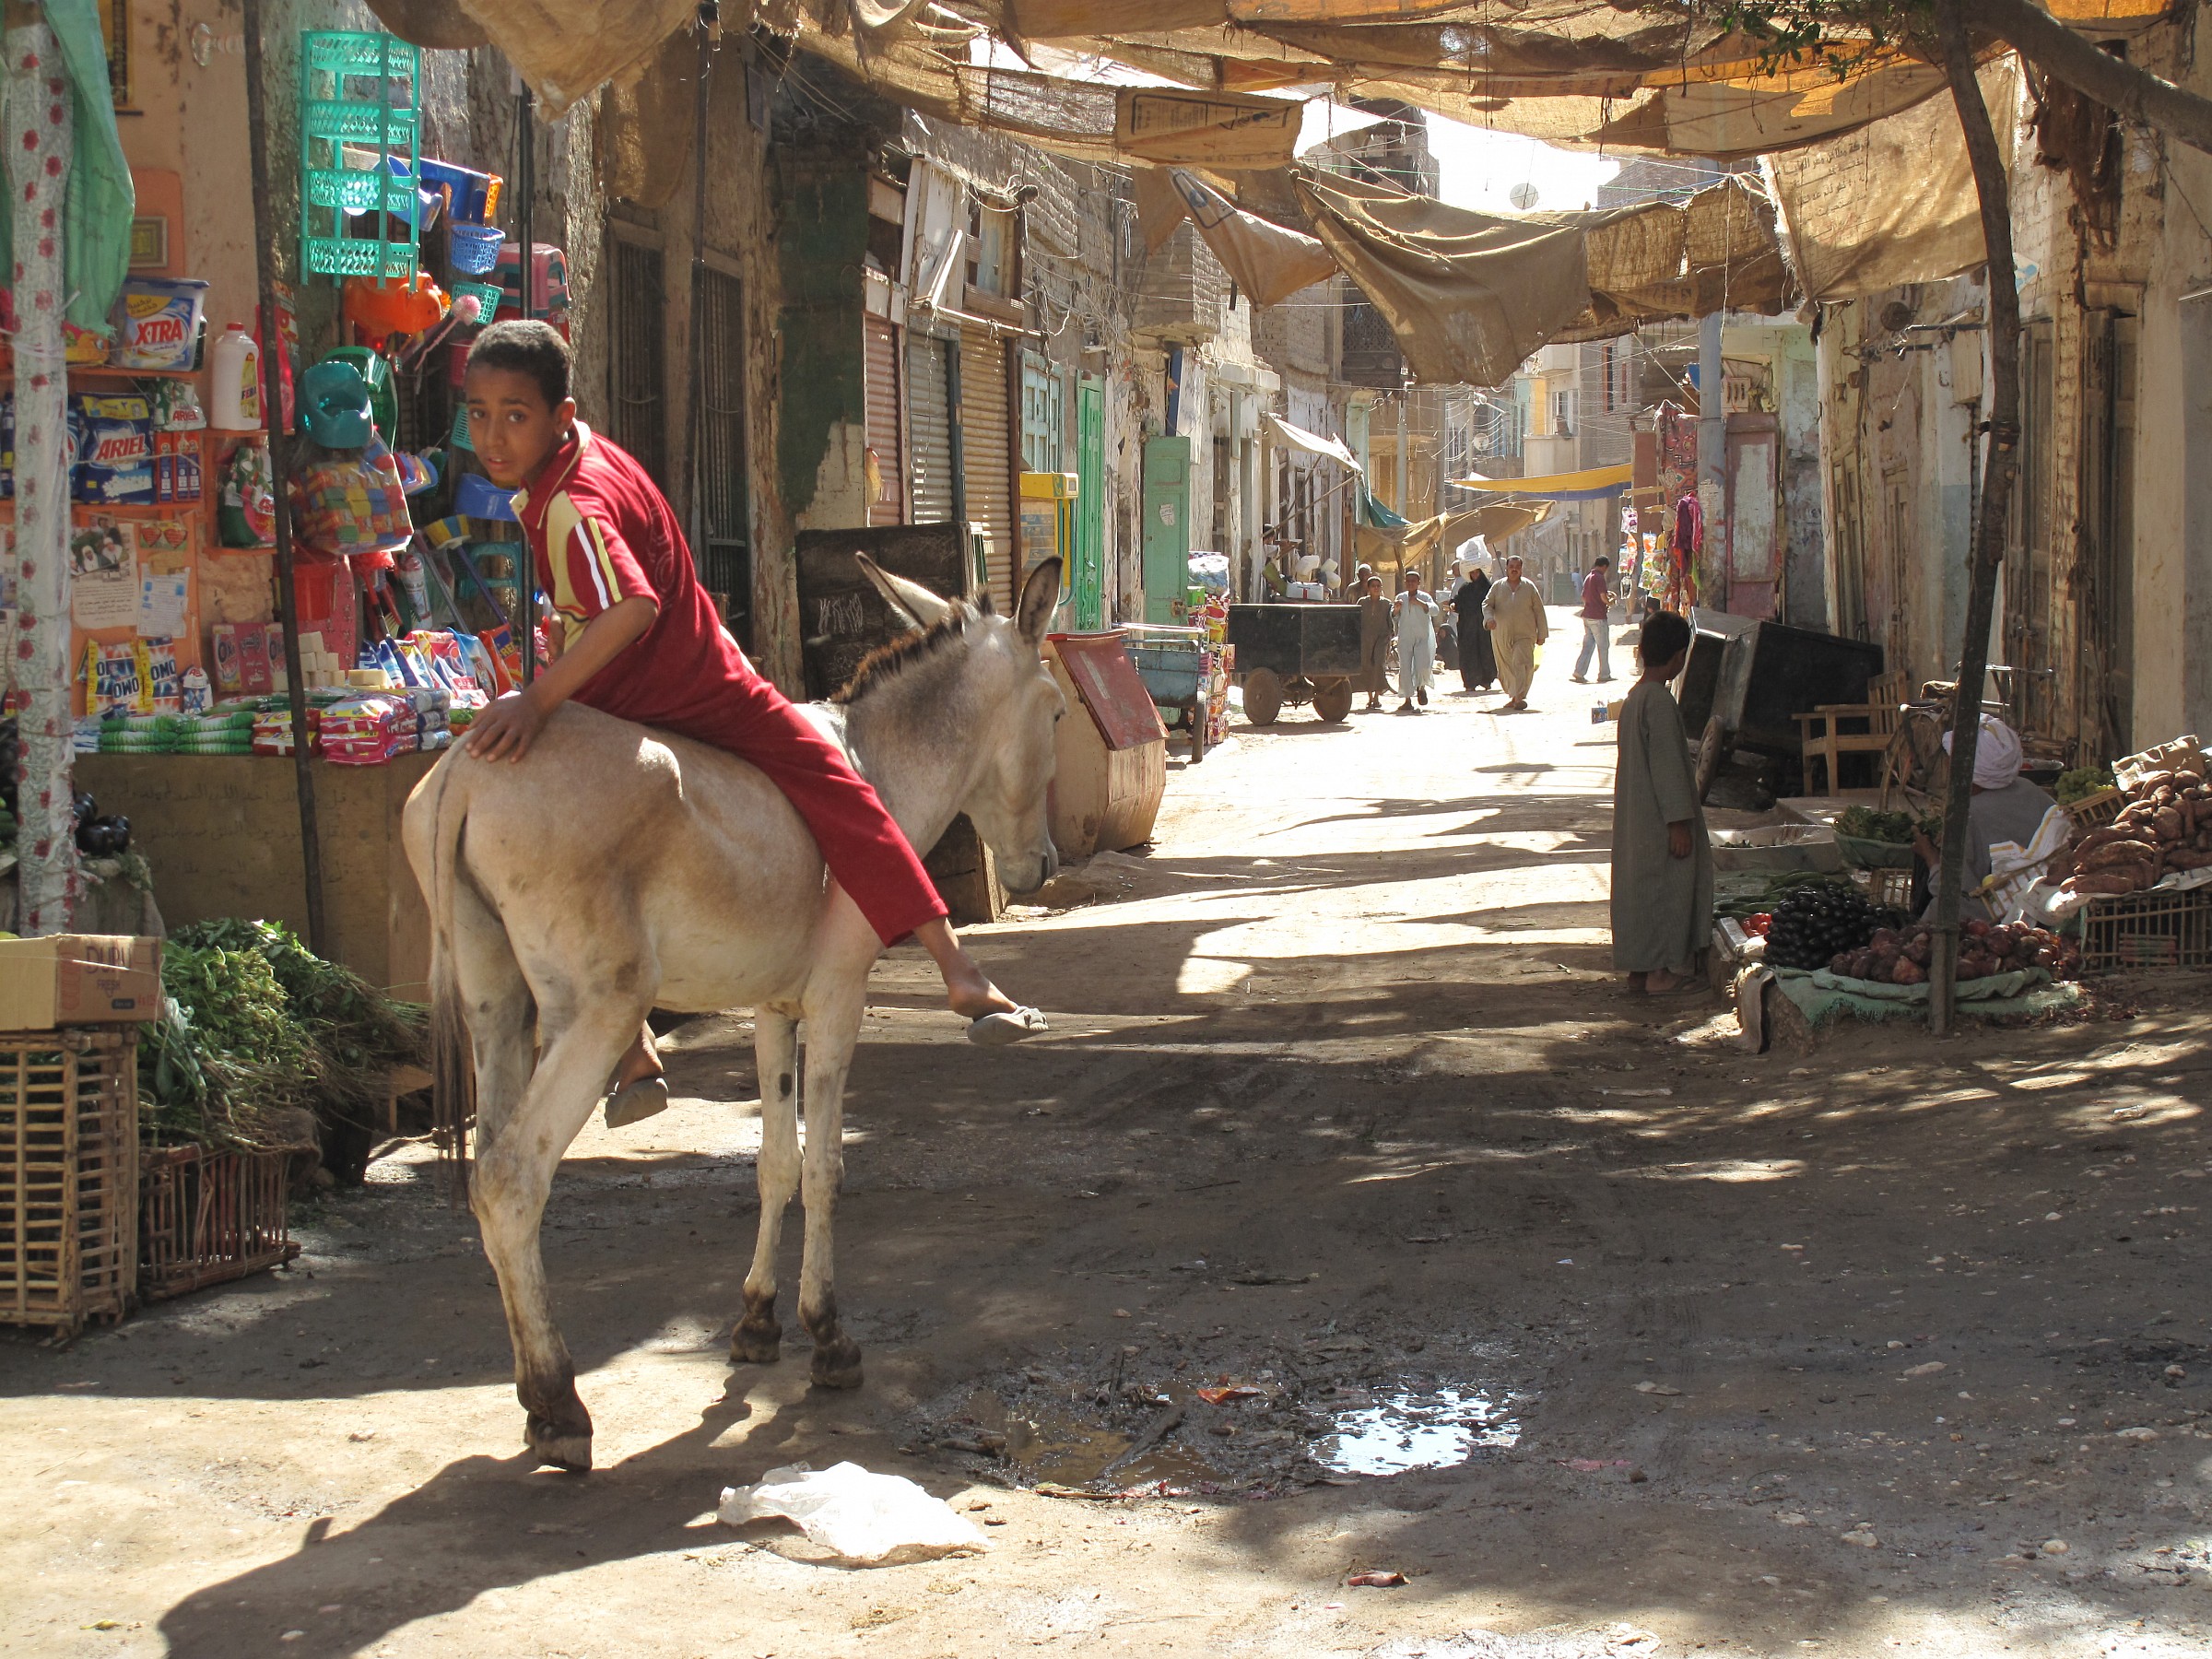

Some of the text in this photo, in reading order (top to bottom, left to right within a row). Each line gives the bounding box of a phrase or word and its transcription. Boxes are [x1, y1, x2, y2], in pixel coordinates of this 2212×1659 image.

[172, 409, 199, 422] ARIEL
[95, 433, 147, 461] ARIEL
[150, 658, 177, 681] OMO
